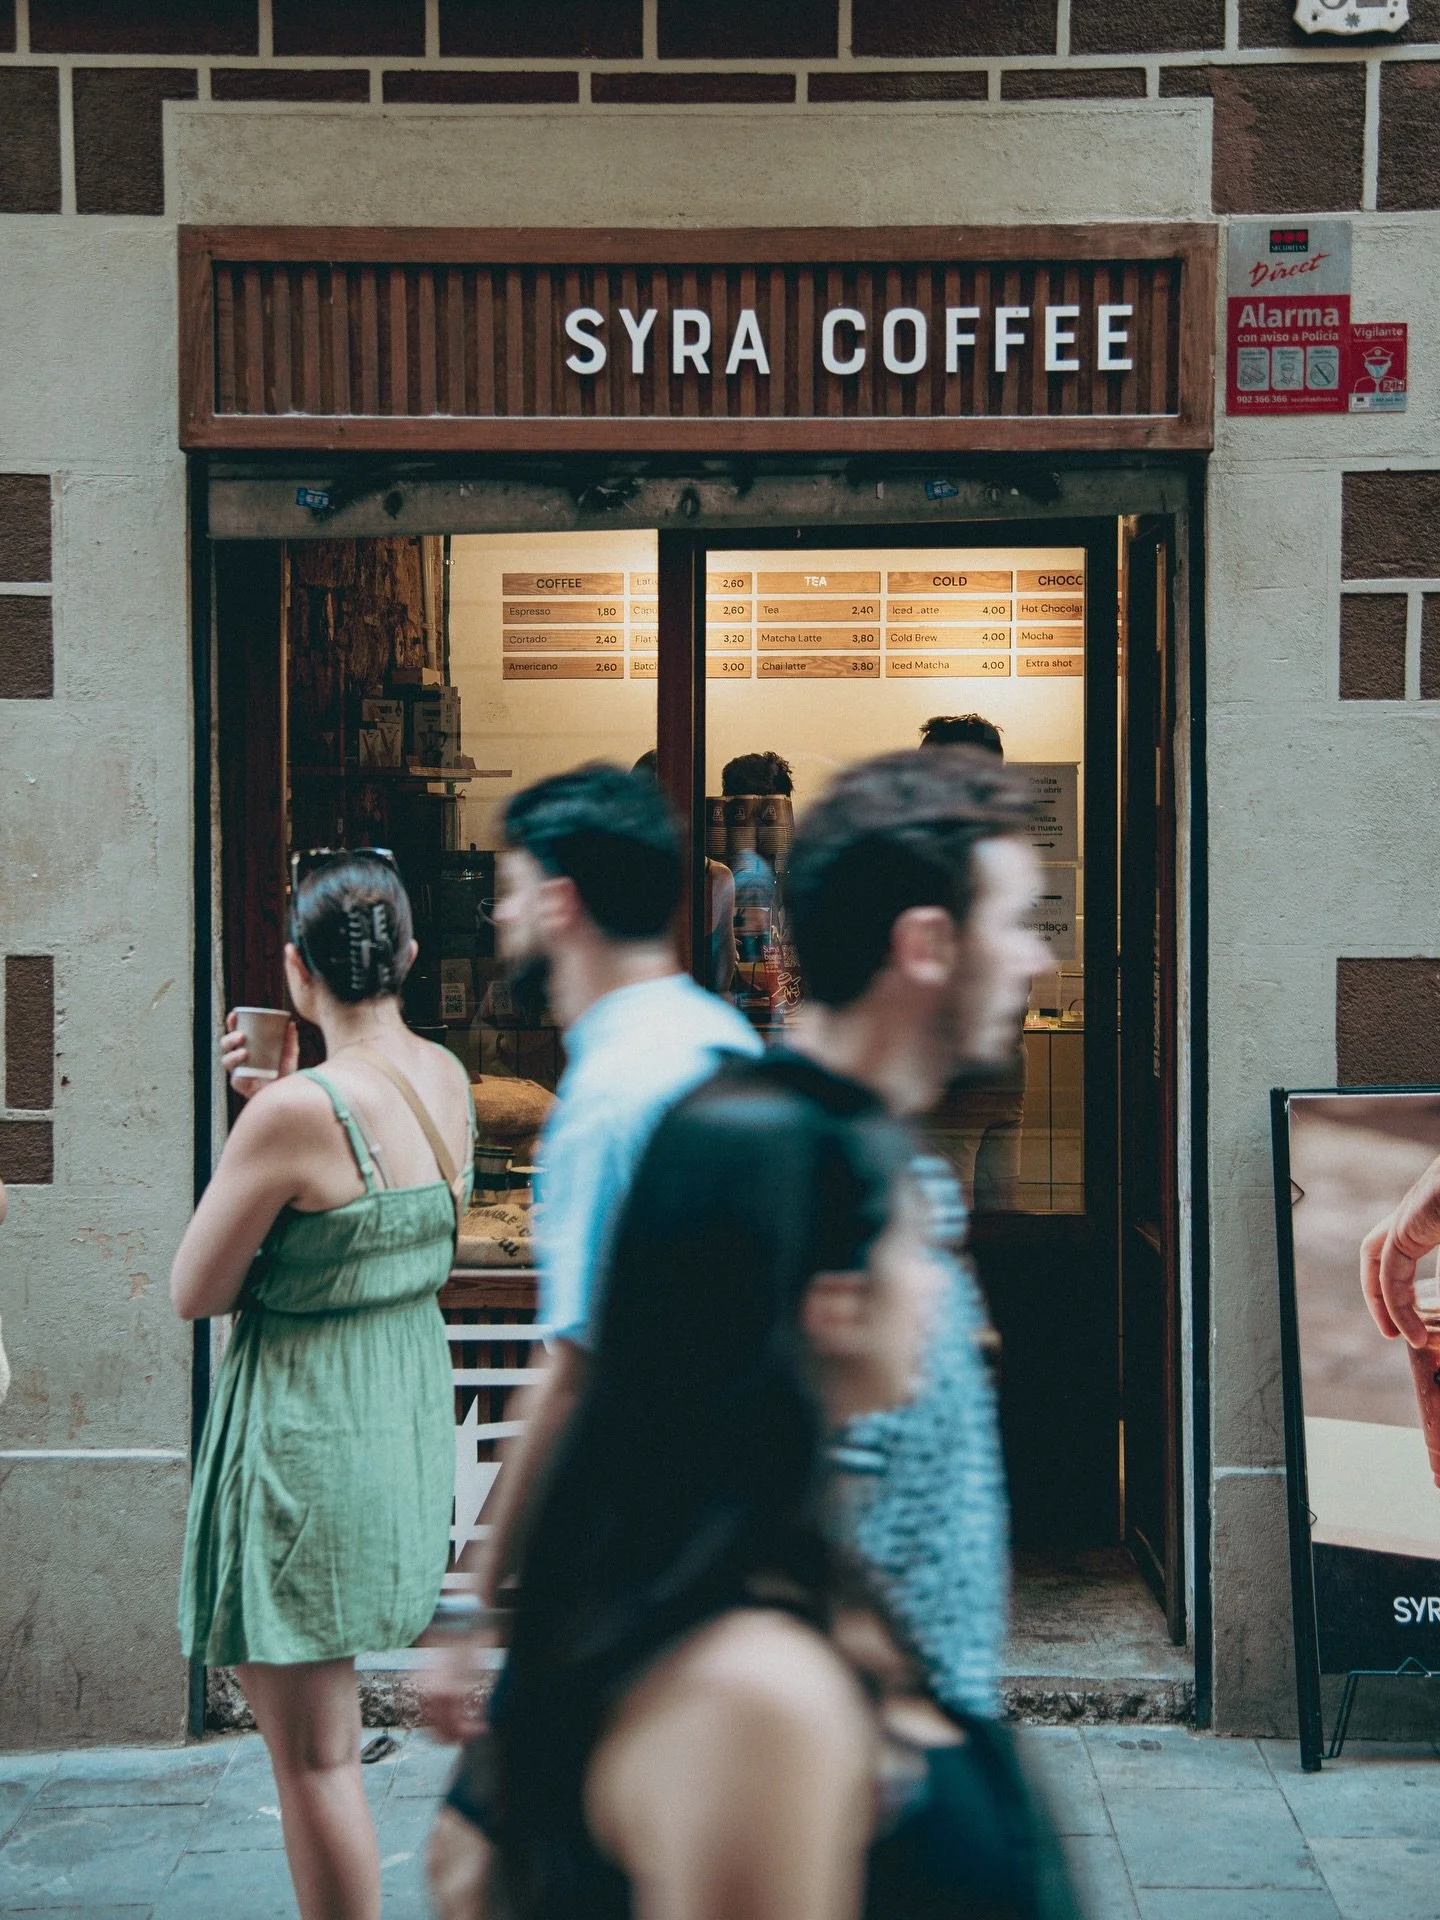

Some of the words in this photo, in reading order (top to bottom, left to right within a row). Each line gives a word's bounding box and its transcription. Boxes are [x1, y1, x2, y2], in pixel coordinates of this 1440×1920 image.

[1249, 253, 1330, 287] Direct
[1238, 303, 1340, 328] Alarma
[1238, 334, 1258, 343] con
[1260, 331, 1290, 343] aviso
[1291, 334, 1299, 342] a
[1353, 326, 1404, 339] Vigilante
[564, 307, 770, 375] SYRA
[822, 305, 1134, 375] COFFEE
[1236, 395, 1253, 404] 902
[1254, 395, 1270, 404] 366
[1272, 395, 1288, 403] 366
[536, 578, 582, 589] COFFEE
[722, 579, 744, 589] 2,60
[804, 576, 828, 587] TEA
[932, 576, 968, 587] COLD
[509, 607, 551, 618] Espresso
[597, 607, 617, 617] 1,80
[723, 606, 745, 616] 2,60
[763, 605, 779, 614] Tea
[851, 606, 874, 616] 2,40
[892, 606, 913, 615] Iced
[915, 606, 940, 615] atte
[982, 606, 1006, 616] 4,00
[1021, 604, 1038, 613] Hot
[509, 635, 547, 644] Cortado
[595, 635, 617, 645] 2,40
[635, 635, 652, 644] Flat
[723, 634, 745, 644] 3,20
[761, 634, 796, 643] Matcha
[798, 634, 822, 643] Latte
[852, 634, 874, 644] 3,80
[890, 633, 913, 643] Cold
[914, 633, 938, 643] Brew
[982, 632, 1006, 642] 4,00
[1021, 631, 1054, 640] Mocha
[509, 662, 558, 671] Americano
[596, 663, 617, 672] 2,60
[722, 662, 745, 672] 3,00
[762, 661, 783, 671] Chai
[784, 661, 807, 671] latte
[851, 662, 874, 672] 3,80
[891, 661, 913, 670] Iced
[914, 660, 950, 670] Matcha
[981, 661, 1005, 671] 4,00
[1025, 659, 1050, 668] Extra
[1052, 659, 1072, 668] shot
[1043, 786, 1062, 794] abrir
[1393, 1596, 1440, 1623] SYR
